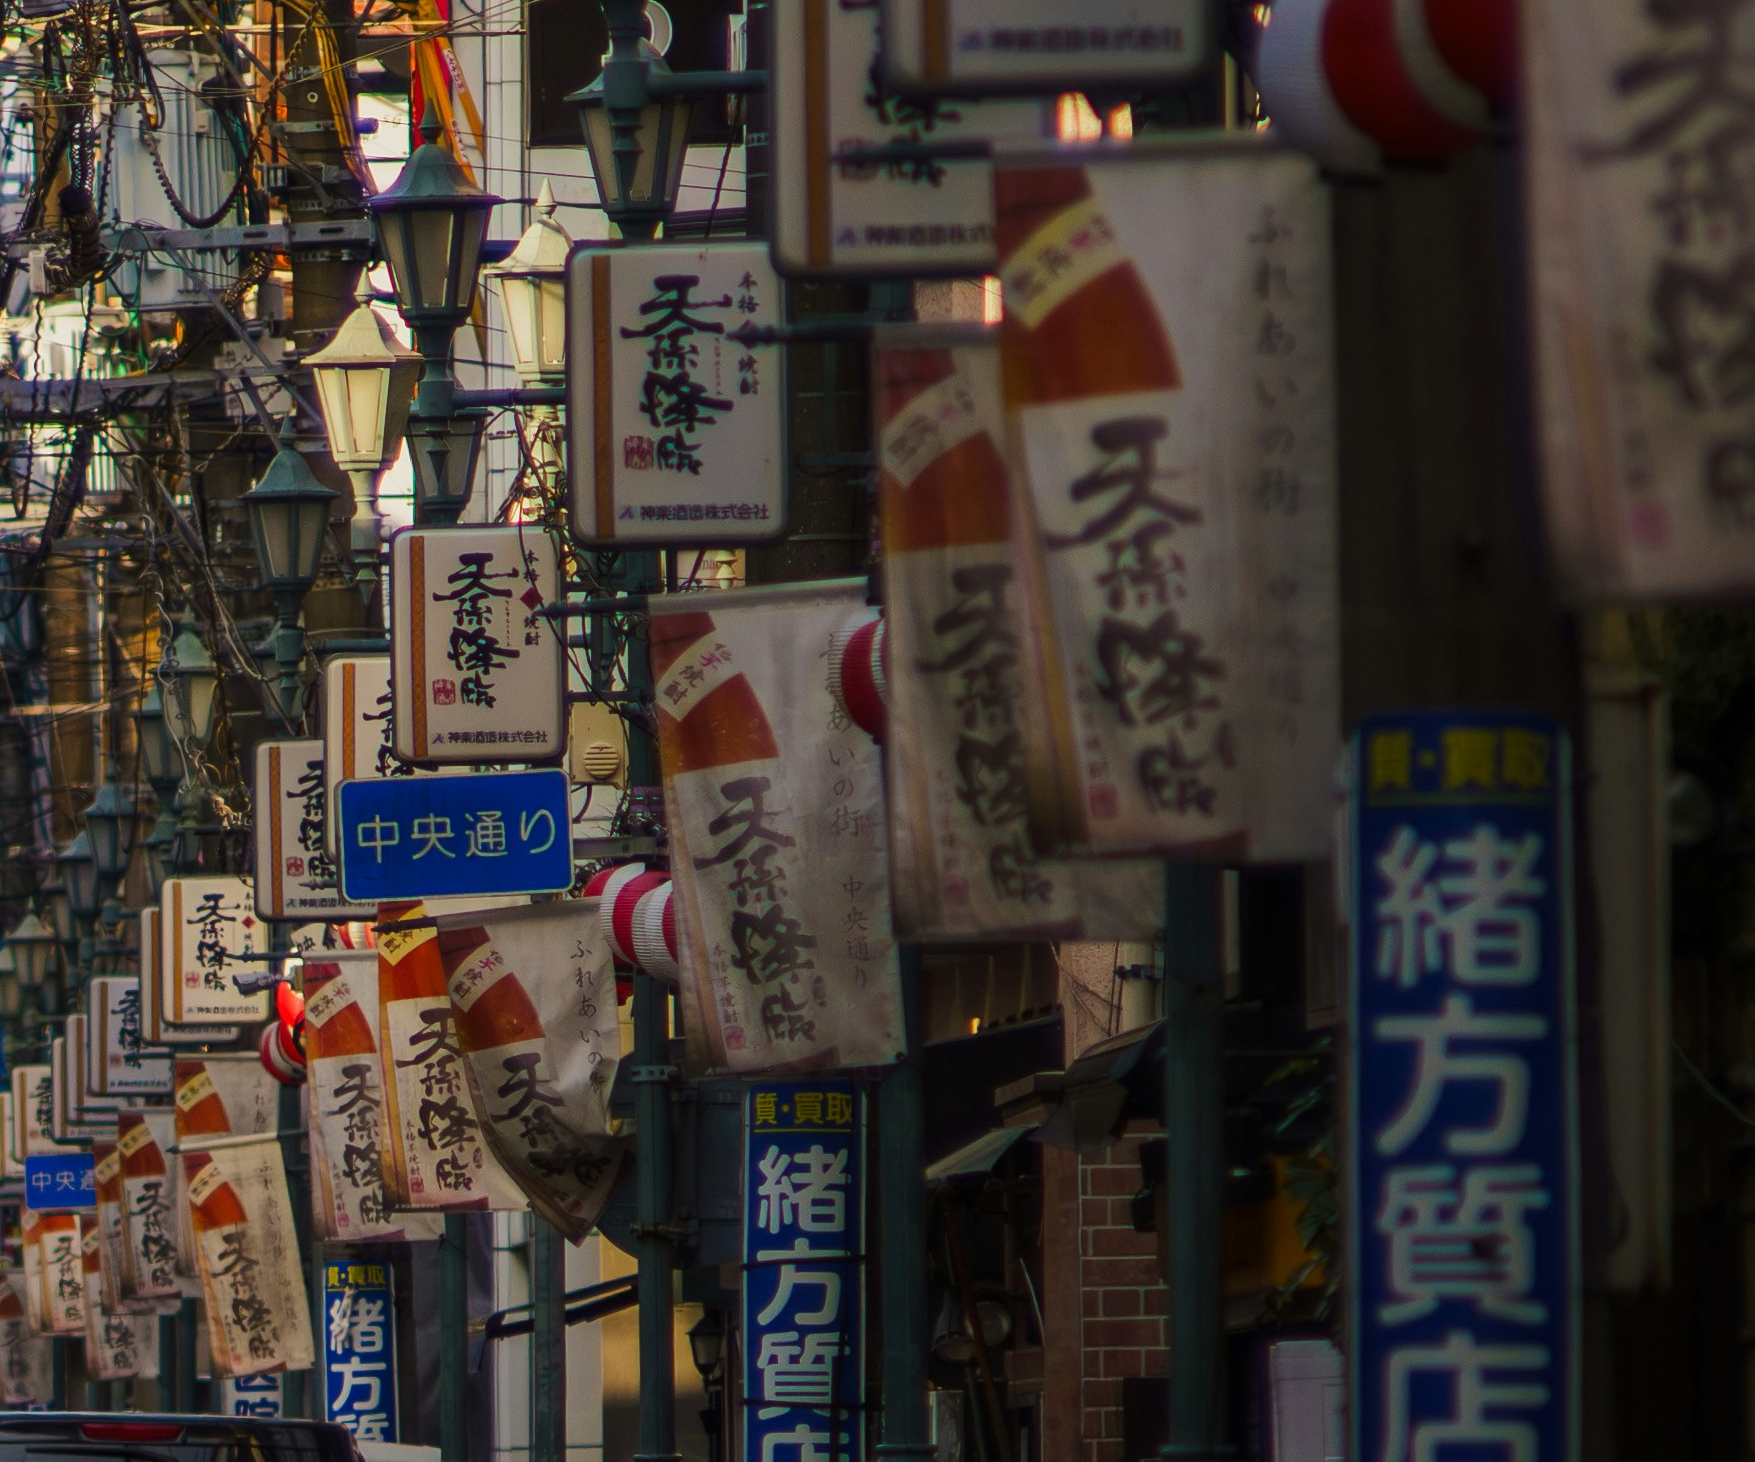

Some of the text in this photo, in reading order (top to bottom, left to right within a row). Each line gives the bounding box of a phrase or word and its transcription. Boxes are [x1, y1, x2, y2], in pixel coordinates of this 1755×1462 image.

[619, 274, 734, 475] 天孫降臨
[640, 503, 768, 521] 神楽酒造株式会社
[432, 552, 520, 708] 天孫降臨
[448, 730, 548, 744] 神楽酒造株式会社
[356, 809, 557, 864] 中央通り
[693, 775, 818, 1042] 天孫降臨
[396, 1008, 478, 1192] 天孫降臨
[753, 1091, 853, 1126] 質・買取
